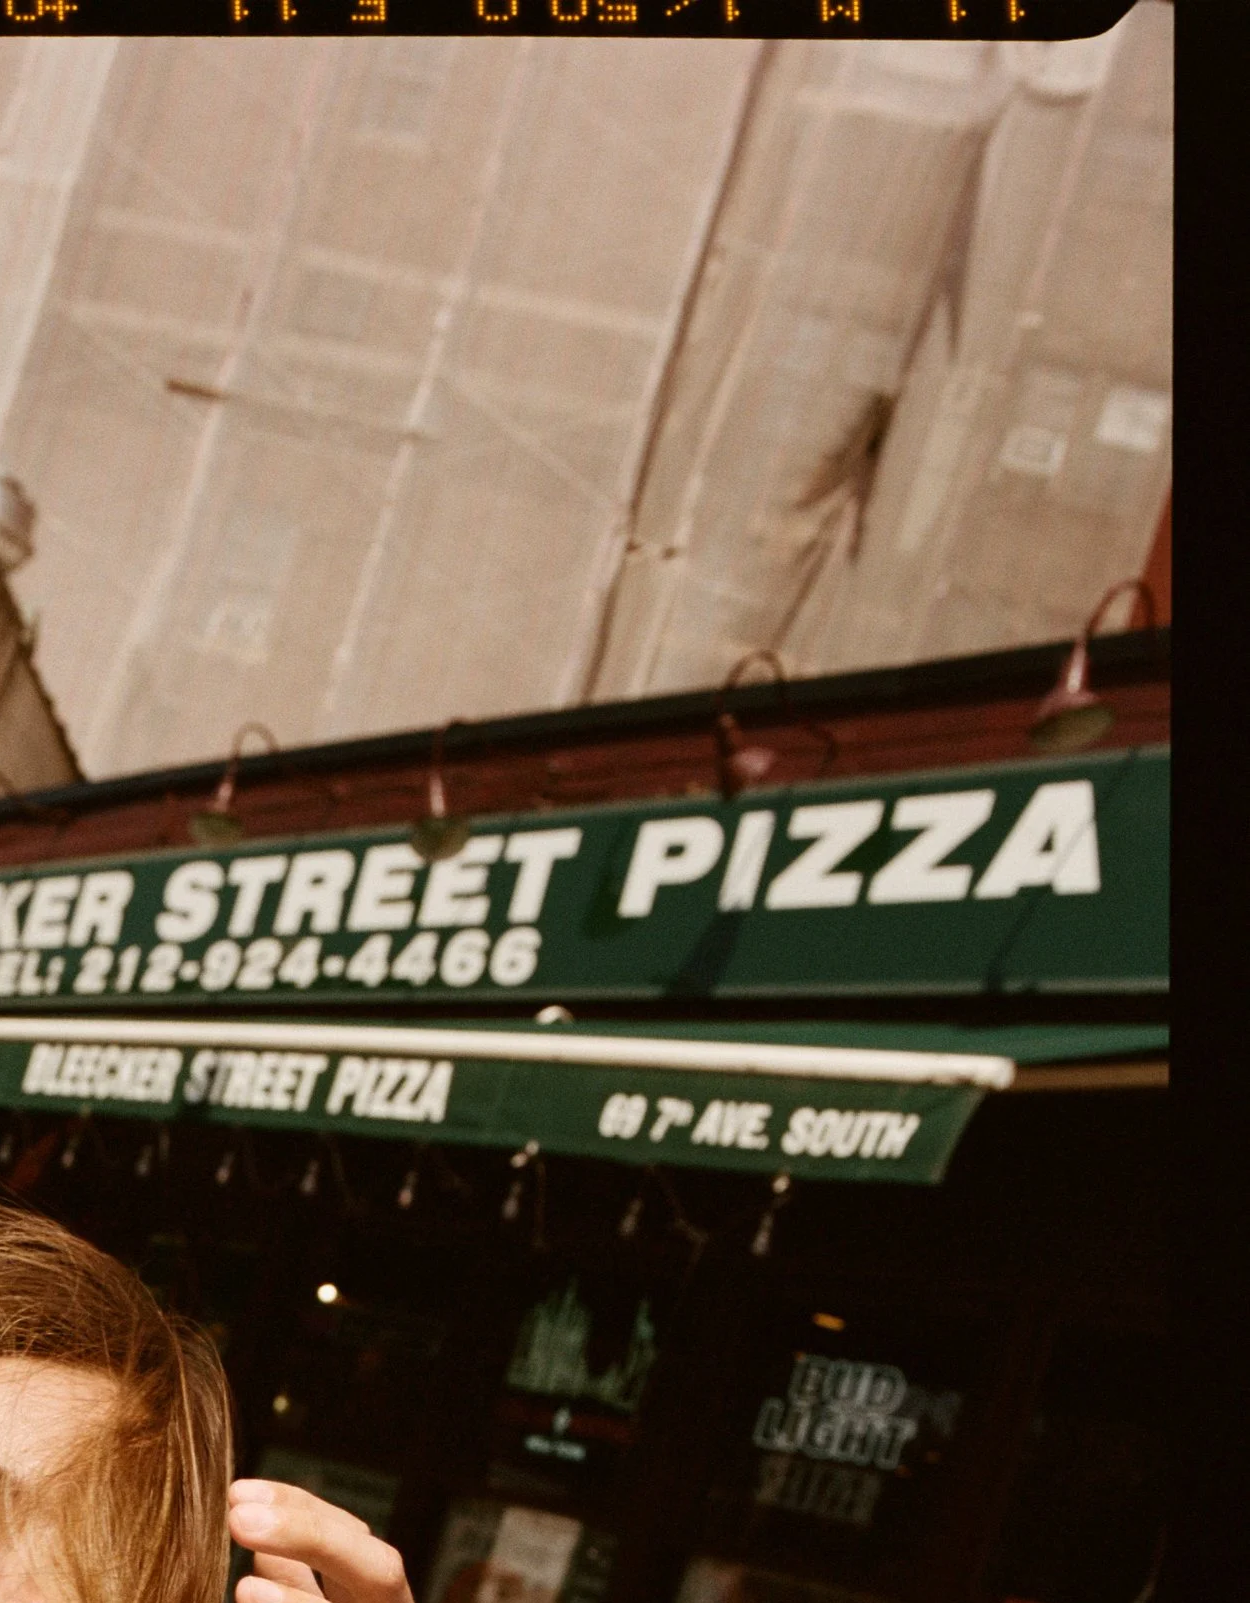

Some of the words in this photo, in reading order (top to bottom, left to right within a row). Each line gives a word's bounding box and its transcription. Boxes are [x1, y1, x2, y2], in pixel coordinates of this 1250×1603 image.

[155, 828, 583, 943] STREET
[618, 780, 1101, 918] PIZZA
[80, 924, 543, 994] 212-924-4466
[21, 1042, 184, 1104] BLEECKER
[184, 1049, 329, 1113] STREET
[326, 1055, 455, 1124] PIZZA
[598, 1093, 648, 1140] 69
[780, 1106, 921, 1159] SOUTH
